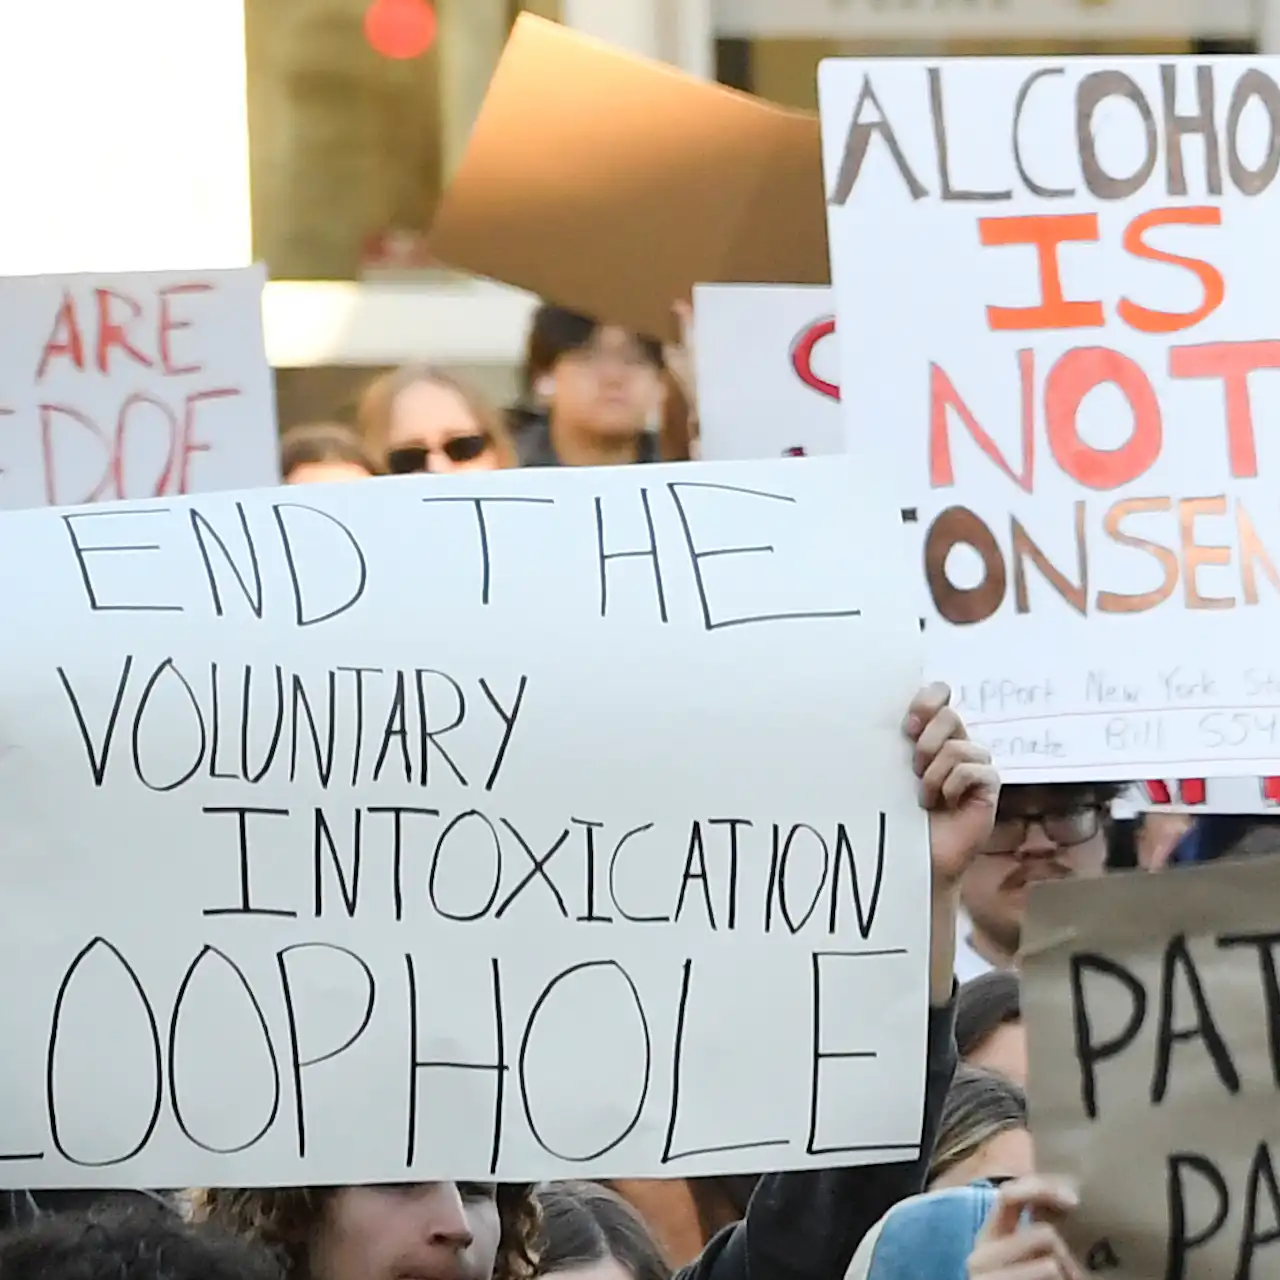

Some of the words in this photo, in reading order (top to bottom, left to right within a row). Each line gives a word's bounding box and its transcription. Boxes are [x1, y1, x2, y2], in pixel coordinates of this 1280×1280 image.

[977, 205, 1226, 333] IS
[35, 283, 215, 381] ARE
[61, 501, 369, 627] END
[423, 480, 861, 630] THE
[57, 654, 528, 791] VOLUNTARY
[955, 676, 1056, 714] upport
[1086, 669, 1141, 705] New
[1157, 664, 1218, 702] York
[991, 728, 1068, 760] enate
[1104, 714, 1168, 752] Bill
[202, 807, 886, 939] INTOXICATION
[1086, 1239, 1121, 1274] a
